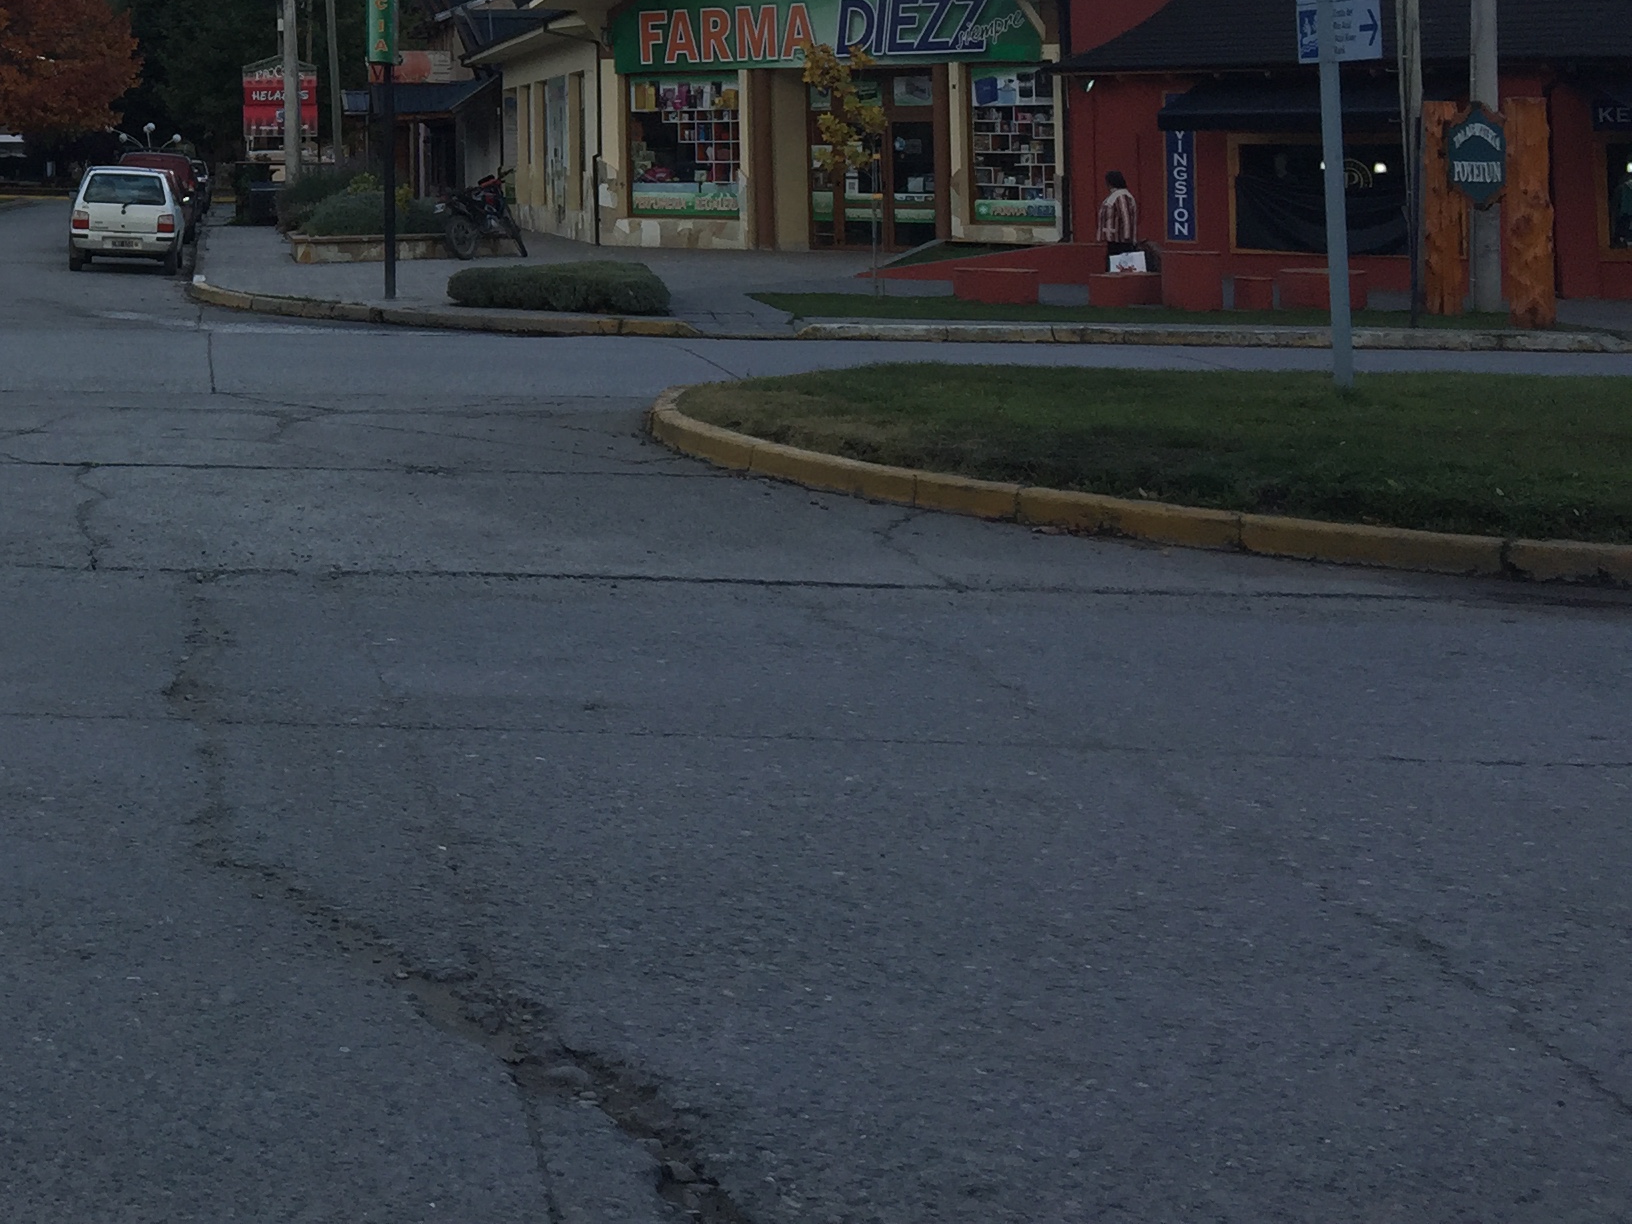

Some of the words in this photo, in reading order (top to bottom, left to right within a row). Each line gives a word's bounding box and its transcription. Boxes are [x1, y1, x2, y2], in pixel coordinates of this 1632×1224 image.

[639, 3, 816, 65] FARMA
[956, 10, 1026, 50] siempre
[252, 90, 309, 101] HELAS
